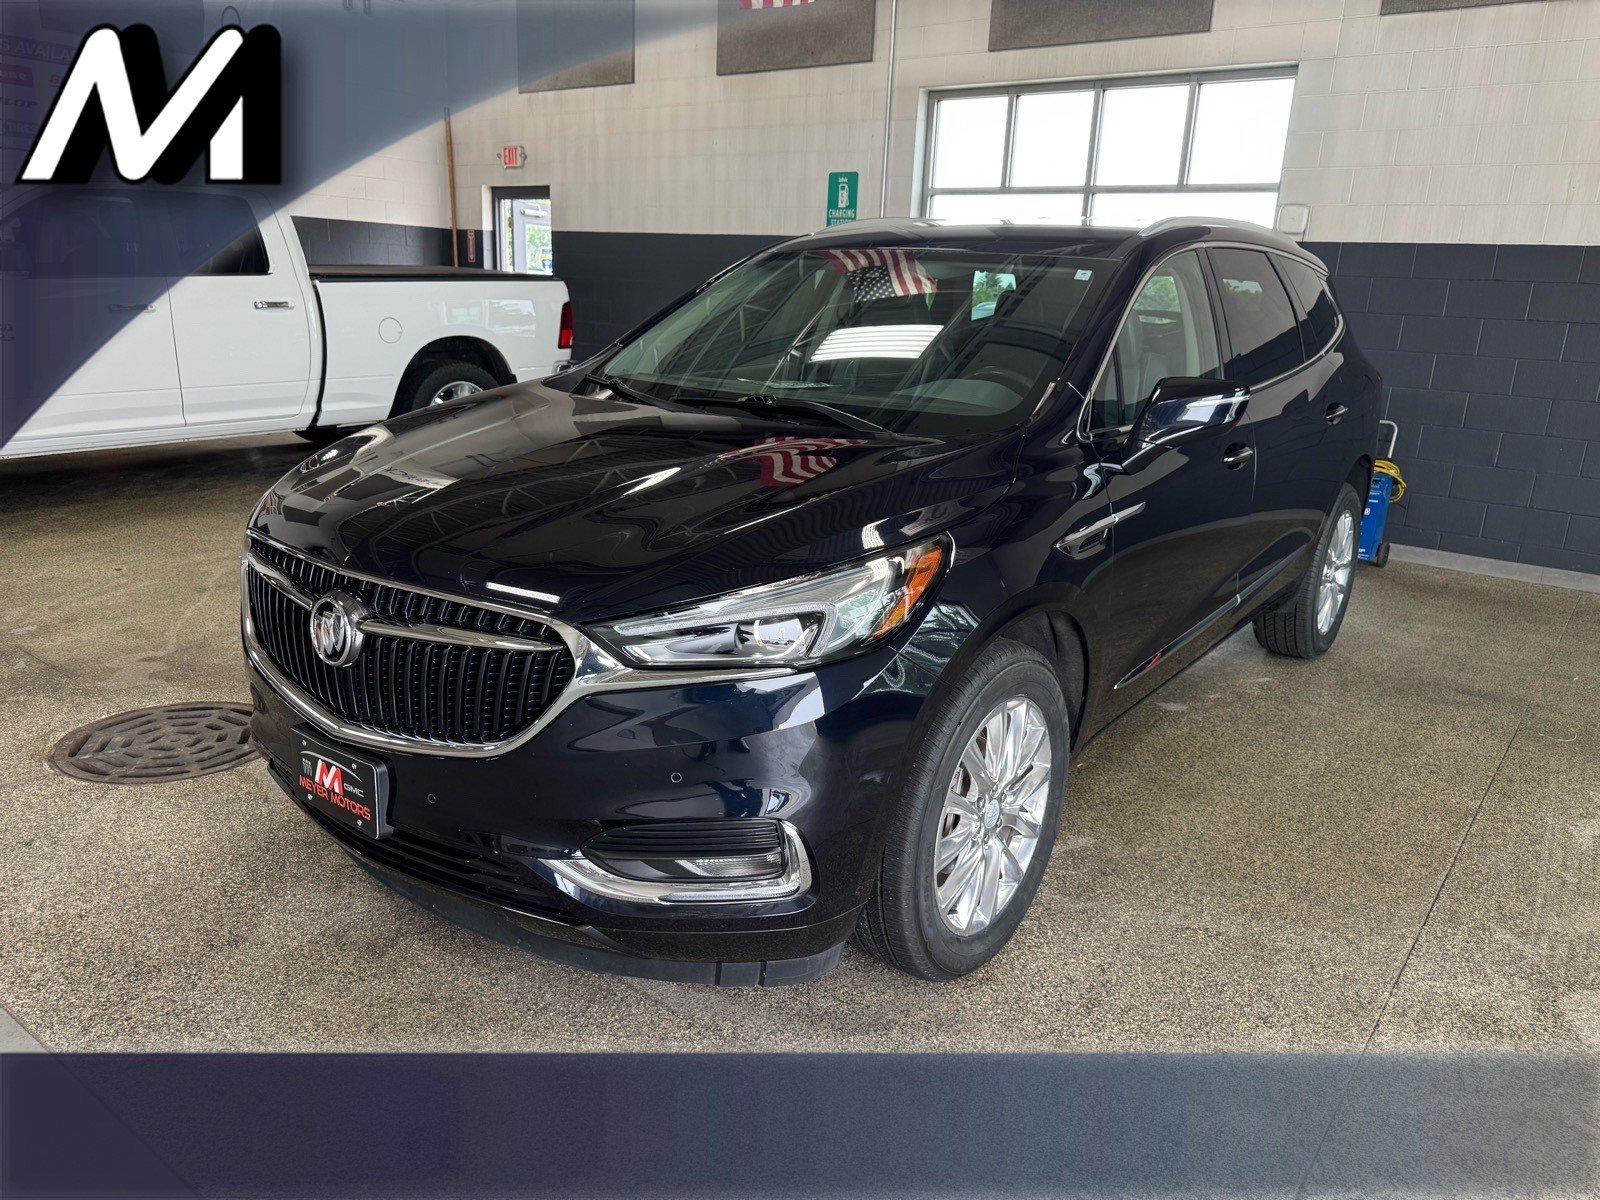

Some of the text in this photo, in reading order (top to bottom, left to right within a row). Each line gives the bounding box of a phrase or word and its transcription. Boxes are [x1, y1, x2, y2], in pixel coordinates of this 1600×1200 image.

[503, 147, 518, 165] EXIT
[829, 208, 855, 218] CHARGING
[299, 774, 371, 821] MEYER MOTORS
[343, 782, 365, 798] GMC
